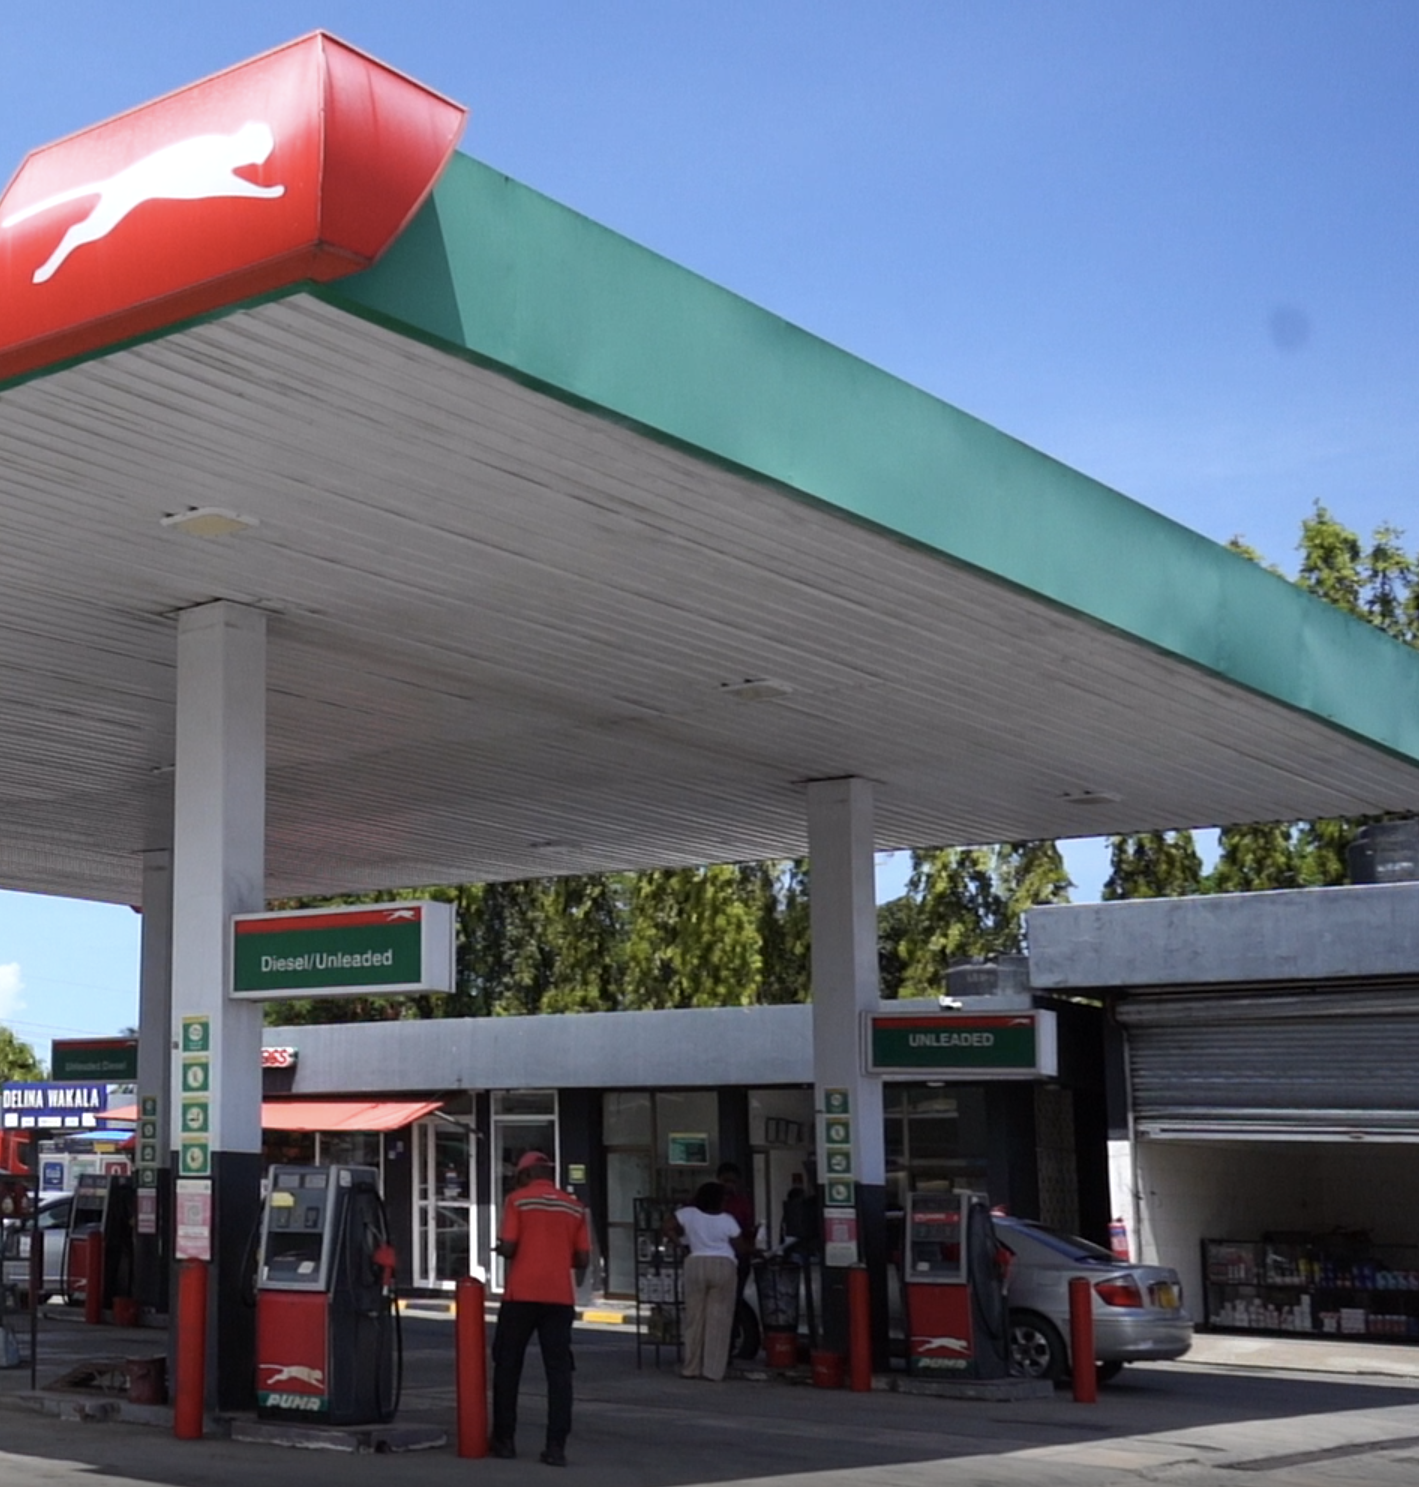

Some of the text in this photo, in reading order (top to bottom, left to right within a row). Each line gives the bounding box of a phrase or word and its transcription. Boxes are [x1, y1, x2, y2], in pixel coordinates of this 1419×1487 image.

[261, 949, 393, 972] Diesel/Unleaded
[909, 1033, 995, 1047] UNLEADED
[2, 1087, 100, 1108] DELINA WAKALA
[266, 1394, 321, 1411] PUMA
